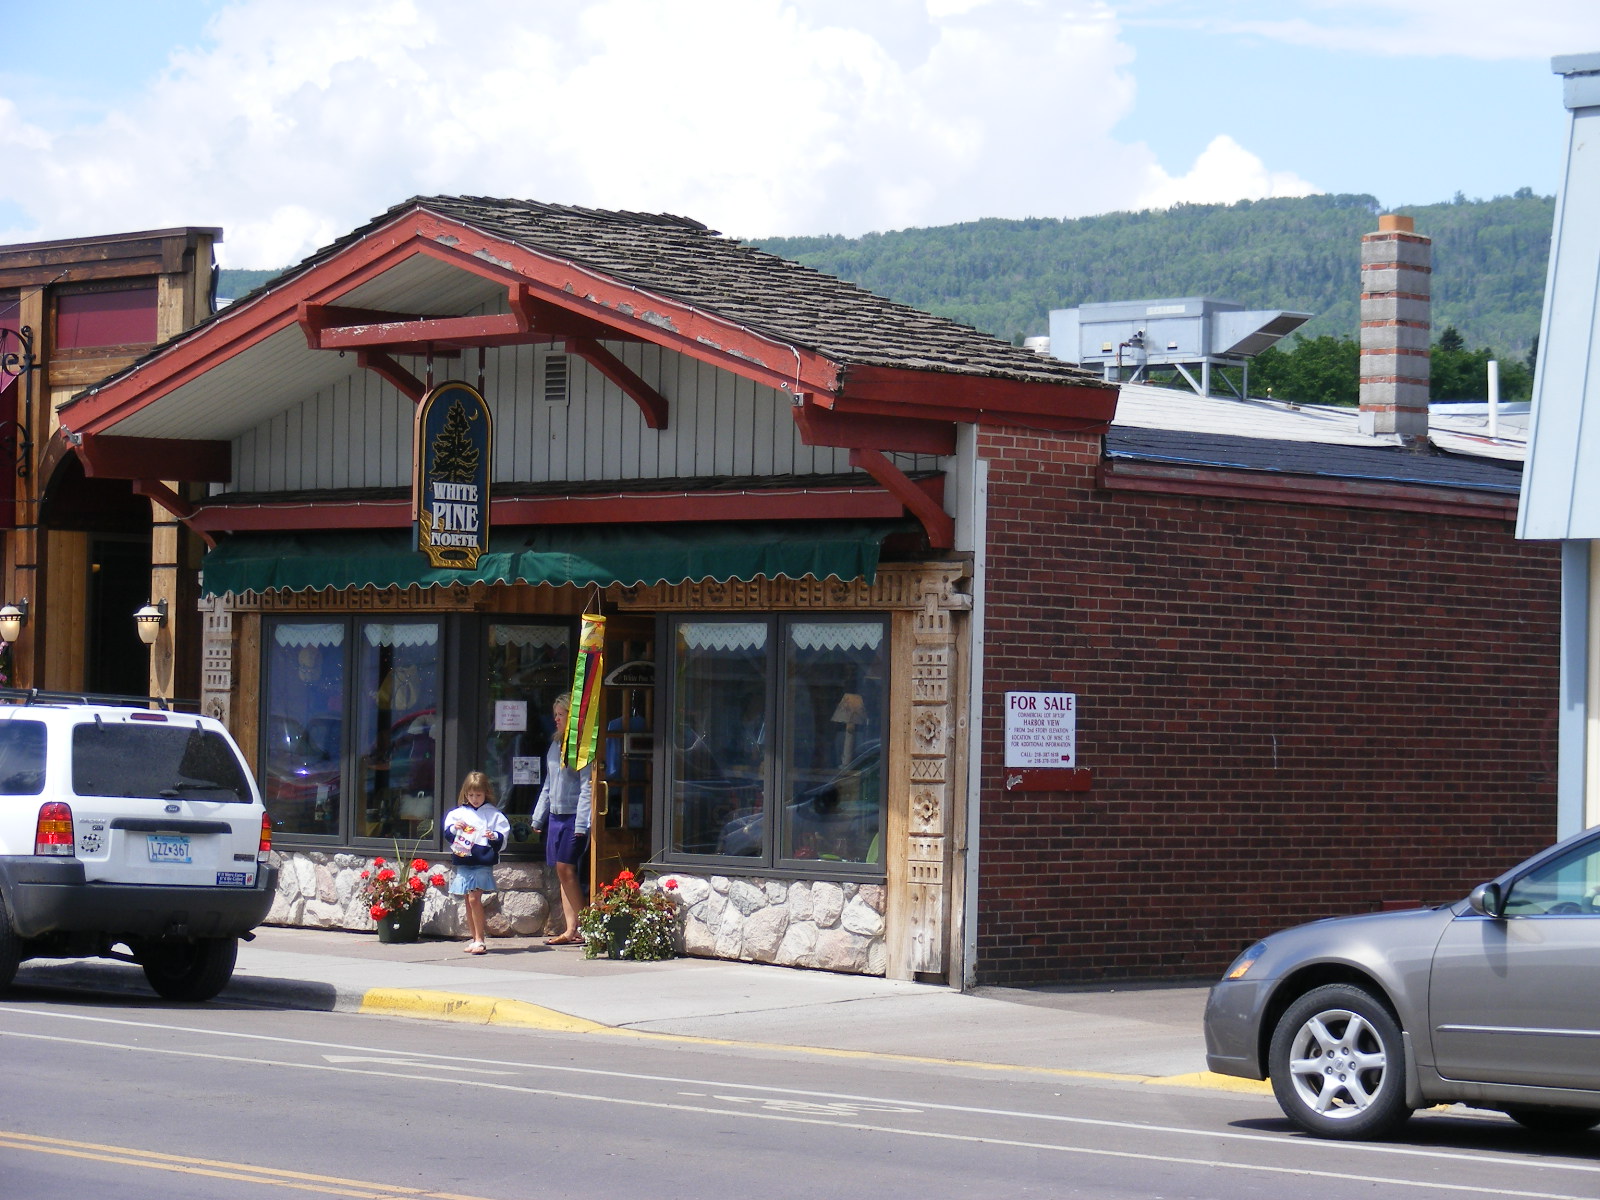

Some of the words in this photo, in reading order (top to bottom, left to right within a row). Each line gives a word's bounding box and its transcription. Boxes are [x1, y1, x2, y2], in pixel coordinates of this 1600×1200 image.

[432, 482, 479, 502] WHITE
[431, 502, 479, 532] PINE
[430, 532, 478, 547] NORTH
[1010, 696, 1037, 710] FOR
[1044, 696, 1072, 711] SALE
[1023, 719, 1045, 727] HARBOR
[1047, 719, 1061, 727] VIEW
